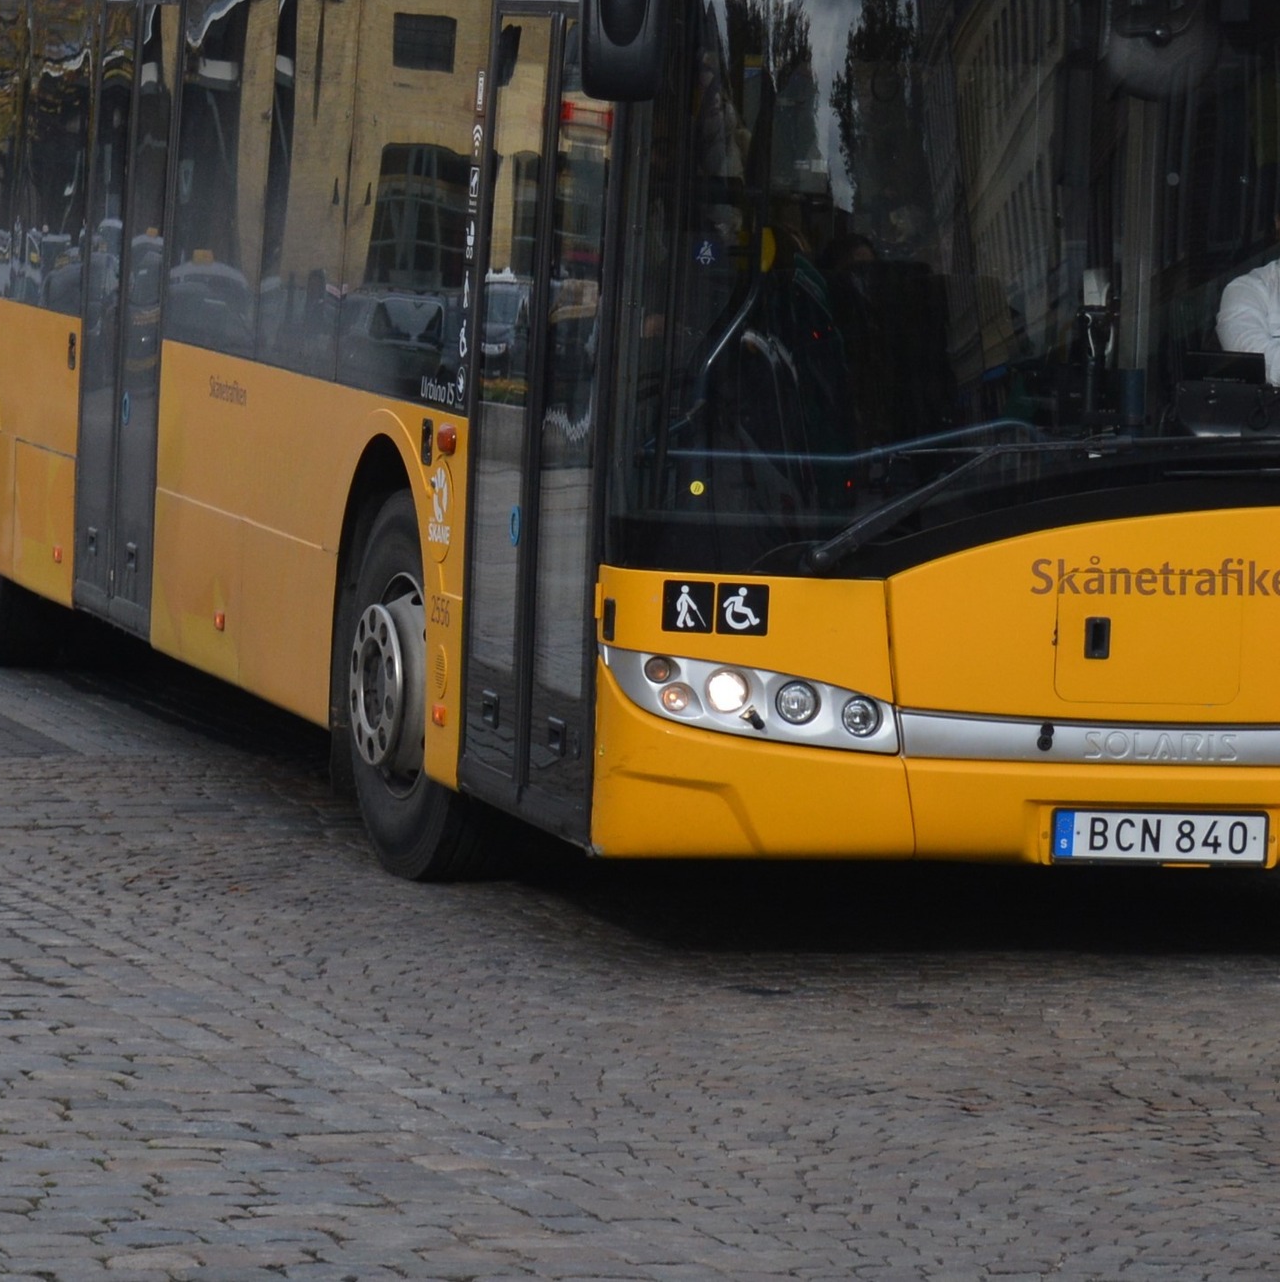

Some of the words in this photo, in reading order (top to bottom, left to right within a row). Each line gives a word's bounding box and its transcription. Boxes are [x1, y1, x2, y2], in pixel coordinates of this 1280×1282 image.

[421, 375, 447, 403] Urbino
[447, 382, 456, 405] 15
[431, 594, 450, 628] 2556
[1083, 731, 1238, 762] SOLARIS
[1060, 838, 1068, 849] S
[1089, 816, 1162, 853] BCN
[1175, 820, 1248, 855] 840
